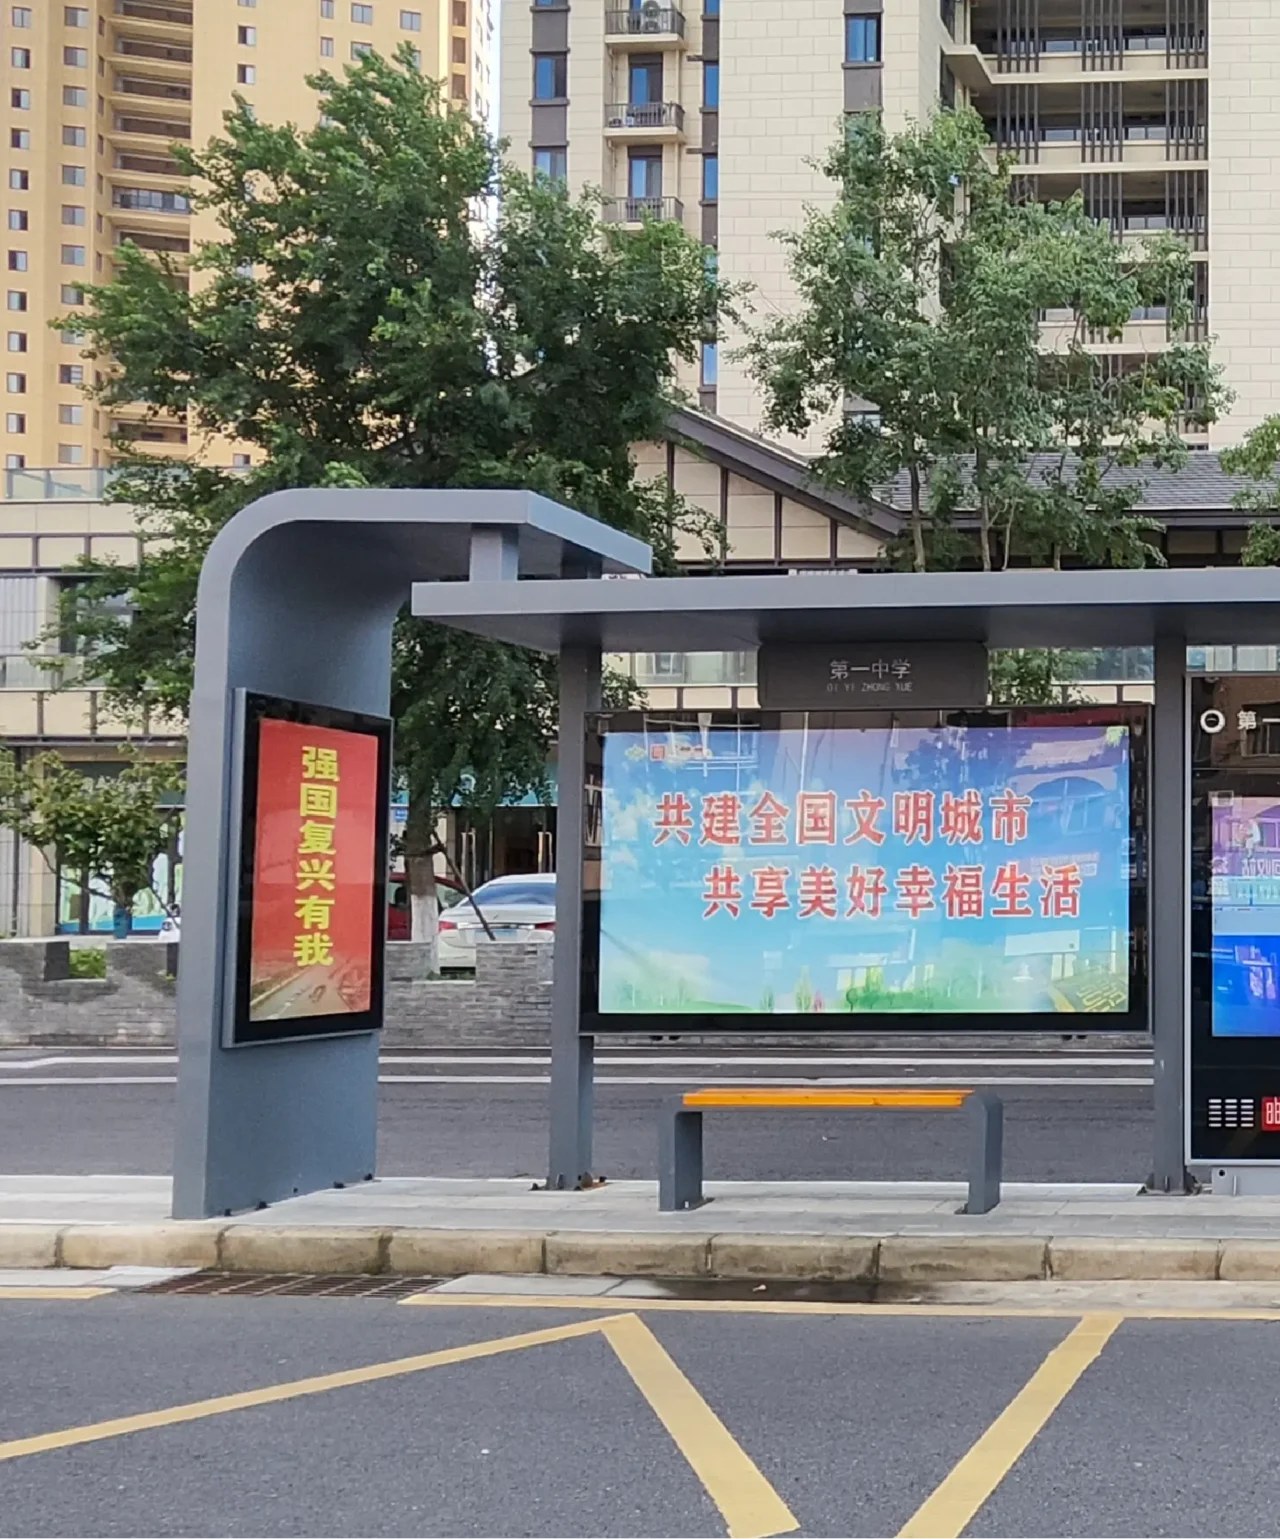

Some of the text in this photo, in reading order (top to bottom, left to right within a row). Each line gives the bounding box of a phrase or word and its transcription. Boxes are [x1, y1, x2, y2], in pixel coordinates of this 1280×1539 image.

[829, 658, 912, 680] 第一中学
[652, 790, 1032, 846] 共建全国文明城市
[293, 745, 341, 968] 强国复兴有我
[702, 864, 1082, 920] 共享美好幸福生活
